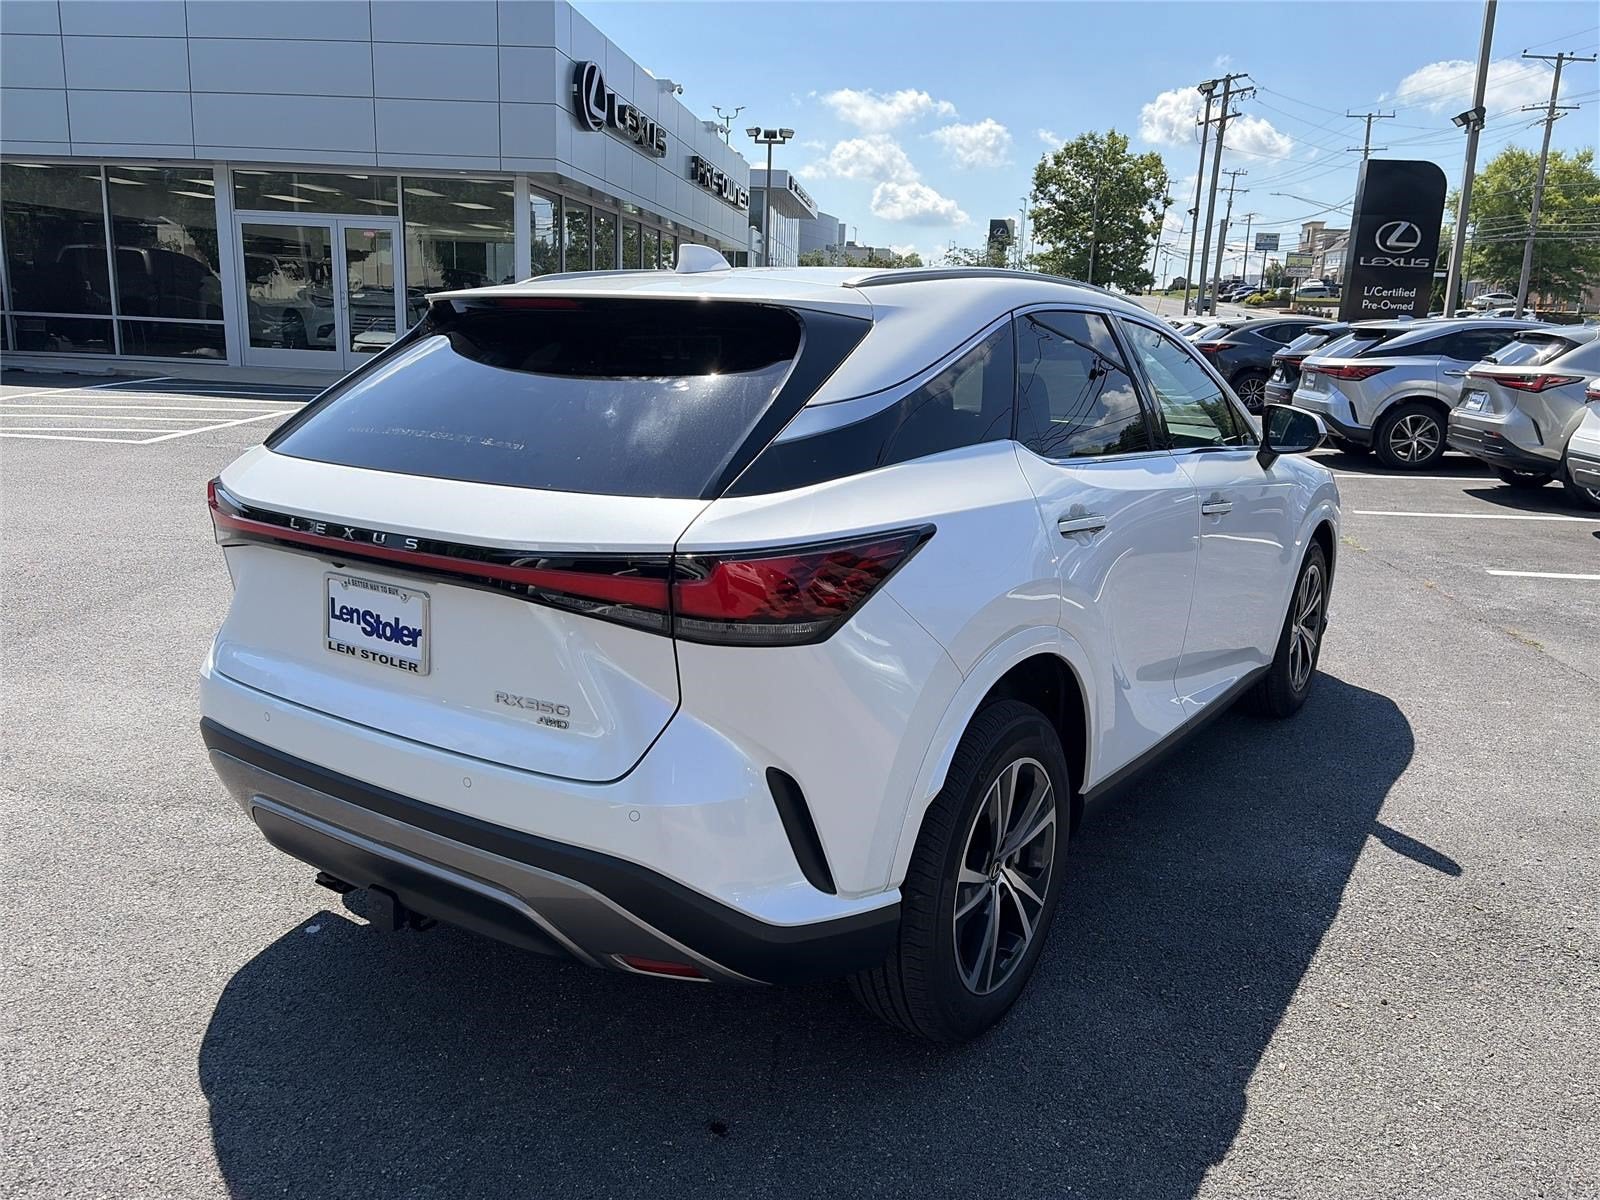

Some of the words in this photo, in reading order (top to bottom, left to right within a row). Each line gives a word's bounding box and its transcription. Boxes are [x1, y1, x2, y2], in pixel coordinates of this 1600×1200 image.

[607, 93, 667, 158] LEXUS
[1359, 256, 1430, 268] LEXUS
[1363, 286, 1417, 298] L/Certified
[1361, 299, 1415, 311] Pre-Owned
[289, 517, 419, 550] LEXUS
[351, 579, 370, 589] BETTER
[380, 585, 388, 594] TO
[328, 640, 356, 656] LEN
[360, 649, 418, 673] STOLER
[495, 690, 571, 717] RX350
[536, 716, 570, 730] AWD
